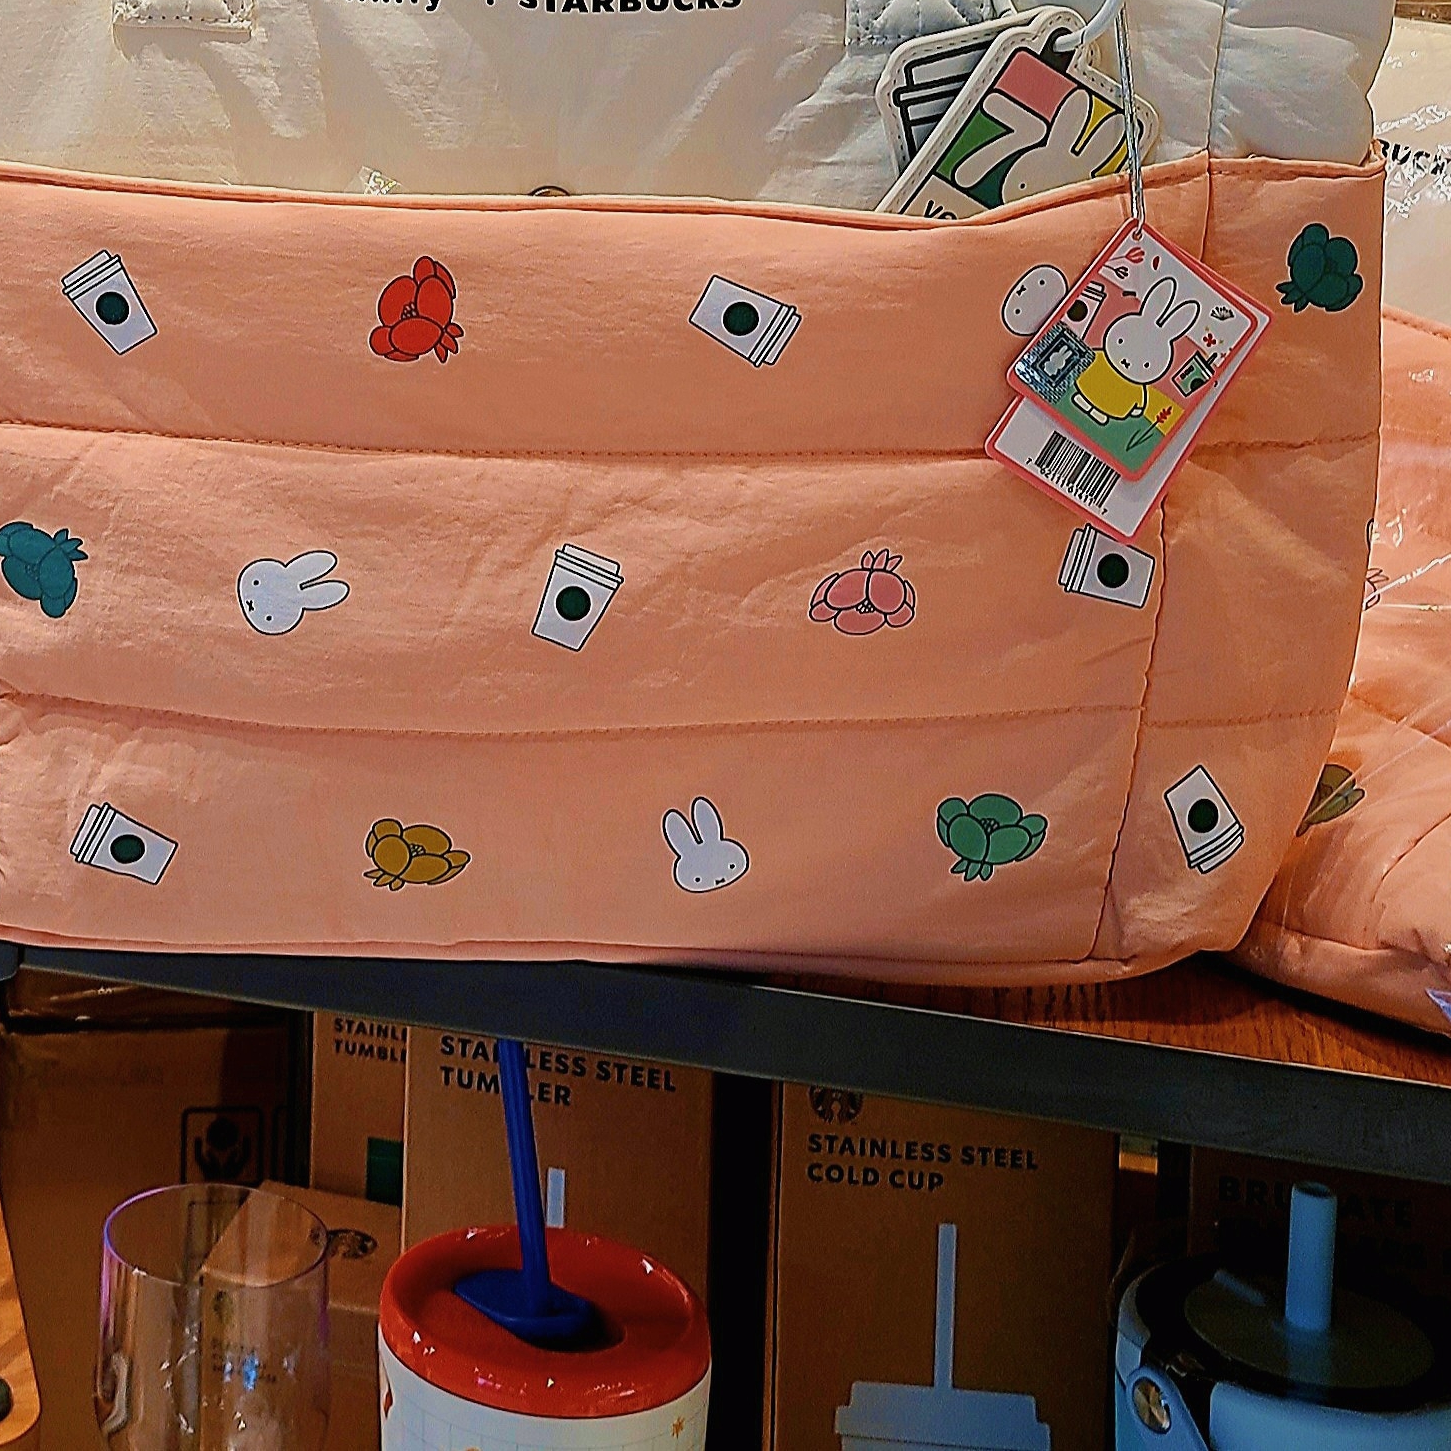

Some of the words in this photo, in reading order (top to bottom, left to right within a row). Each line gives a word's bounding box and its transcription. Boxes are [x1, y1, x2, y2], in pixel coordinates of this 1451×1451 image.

[334, 1018, 407, 1043] STAINL
[334, 1038, 407, 1064] TUMBL
[595, 1060, 676, 1092] STEEL
[807, 1133, 952, 1164] STAINLESS
[960, 1144, 1039, 1171] STEEL
[807, 1162, 880, 1189] COLD
[888, 1168, 945, 1192] CUP
